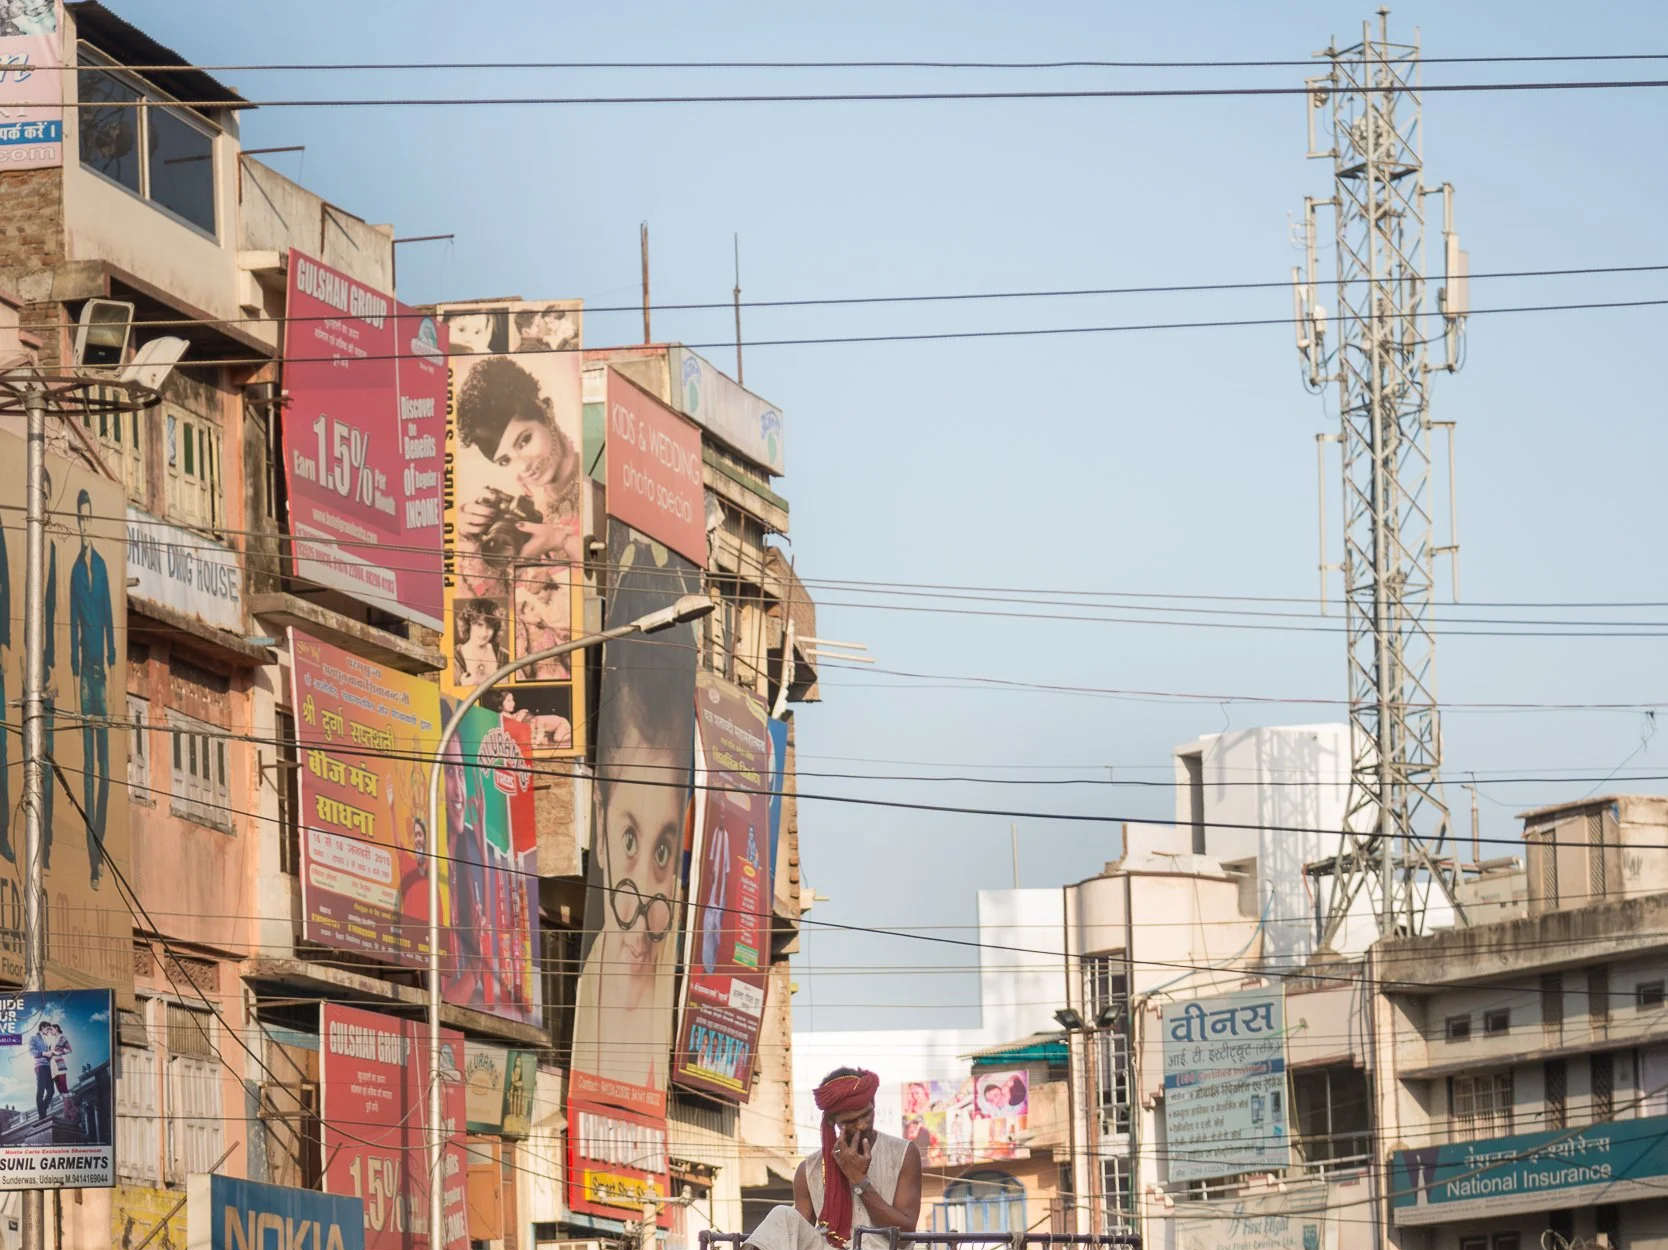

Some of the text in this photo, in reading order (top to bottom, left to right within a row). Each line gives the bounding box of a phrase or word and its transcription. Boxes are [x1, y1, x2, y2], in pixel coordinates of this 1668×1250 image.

[297, 257, 388, 330] GULSHAN GROUP
[401, 395, 435, 420] Discover
[293, 413, 373, 507] Earn 1.5%
[612, 402, 636, 446] KIDS
[650, 427, 699, 486] WEDDING
[403, 462, 416, 496] of
[443, 368, 455, 588] PHOTO VIDEO STUDIO
[622, 462, 693, 524] photo special
[405, 498, 439, 529] INCOME
[196, 555, 239, 602] HOUSE
[303, 694, 316, 726] श्री
[321, 706, 344, 741] दुर्गा
[308, 745, 378, 798] बीज मंत्र
[316, 794, 375, 837] साधना
[2, 957, 23, 976] Floor
[329, 1020, 411, 1068] GULSHAN GROUP
[1170, 1002, 1275, 1042] वीनस
[0, 1156, 109, 1171] SUNIL GARMENTS
[2, 1175, 38, 1186] Sunderwas,
[1446, 1171, 1518, 1198] National
[1522, 1162, 1613, 1189] Insurance
